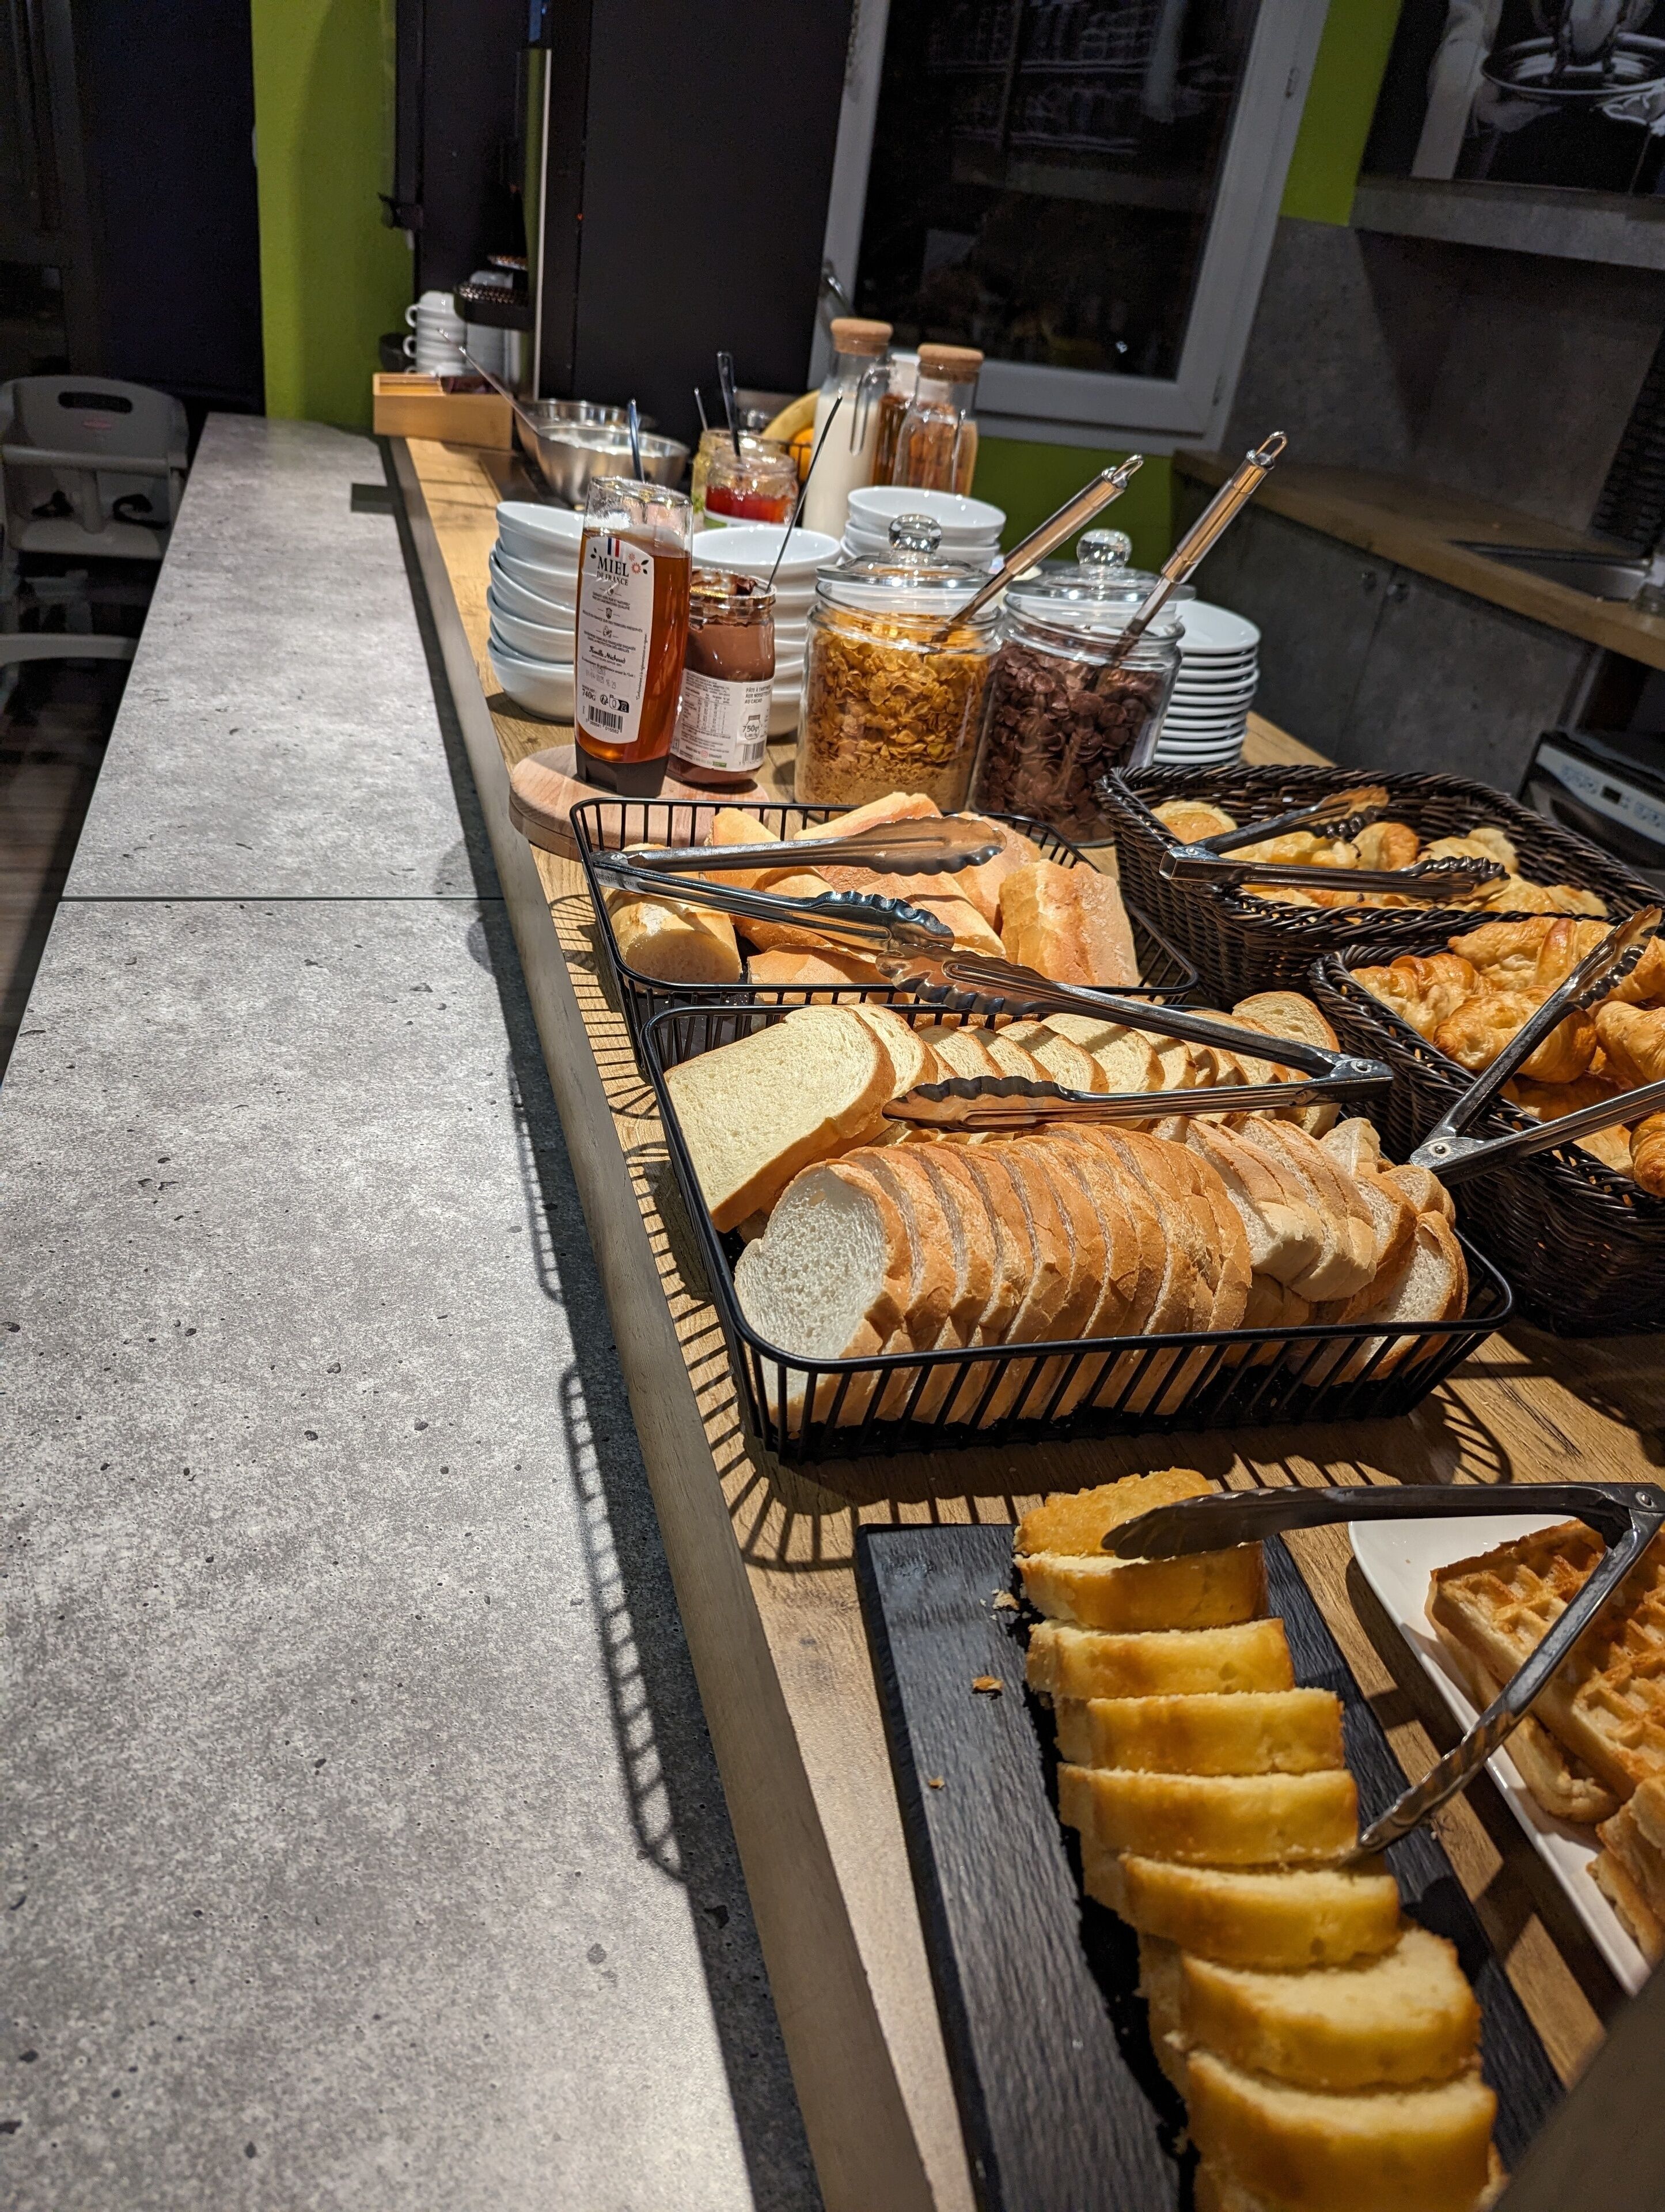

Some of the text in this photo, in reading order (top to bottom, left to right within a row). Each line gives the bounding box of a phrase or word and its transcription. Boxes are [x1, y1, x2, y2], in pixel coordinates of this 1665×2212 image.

[597, 556, 629, 577] MIEL
[597, 571, 629, 586] DE FRANCE
[582, 688, 596, 701] 740G
